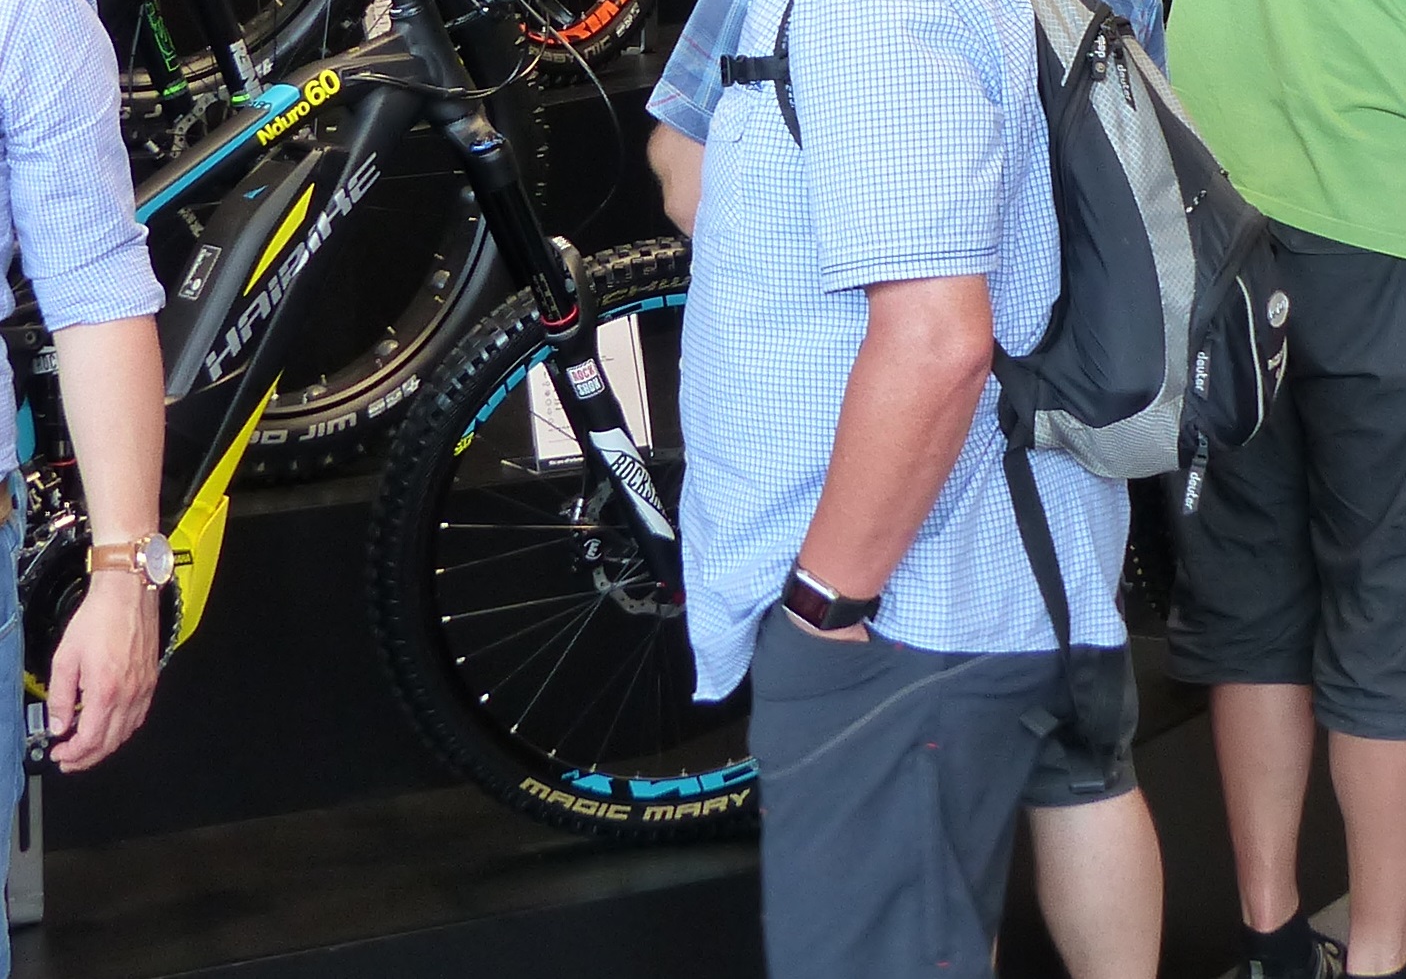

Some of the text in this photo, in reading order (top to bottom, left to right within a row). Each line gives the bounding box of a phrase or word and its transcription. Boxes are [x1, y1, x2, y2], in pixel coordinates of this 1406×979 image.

[1116, 63, 1134, 103] deuter
[255, 101, 311, 146] Nduro
[204, 151, 381, 383] HAIBIKE
[1196, 350, 1206, 392] deuter
[299, 412, 358, 441] JIM
[1184, 471, 1200, 512] deuter
[519, 776, 632, 821] MAGIC
[642, 788, 750, 821] MARY
